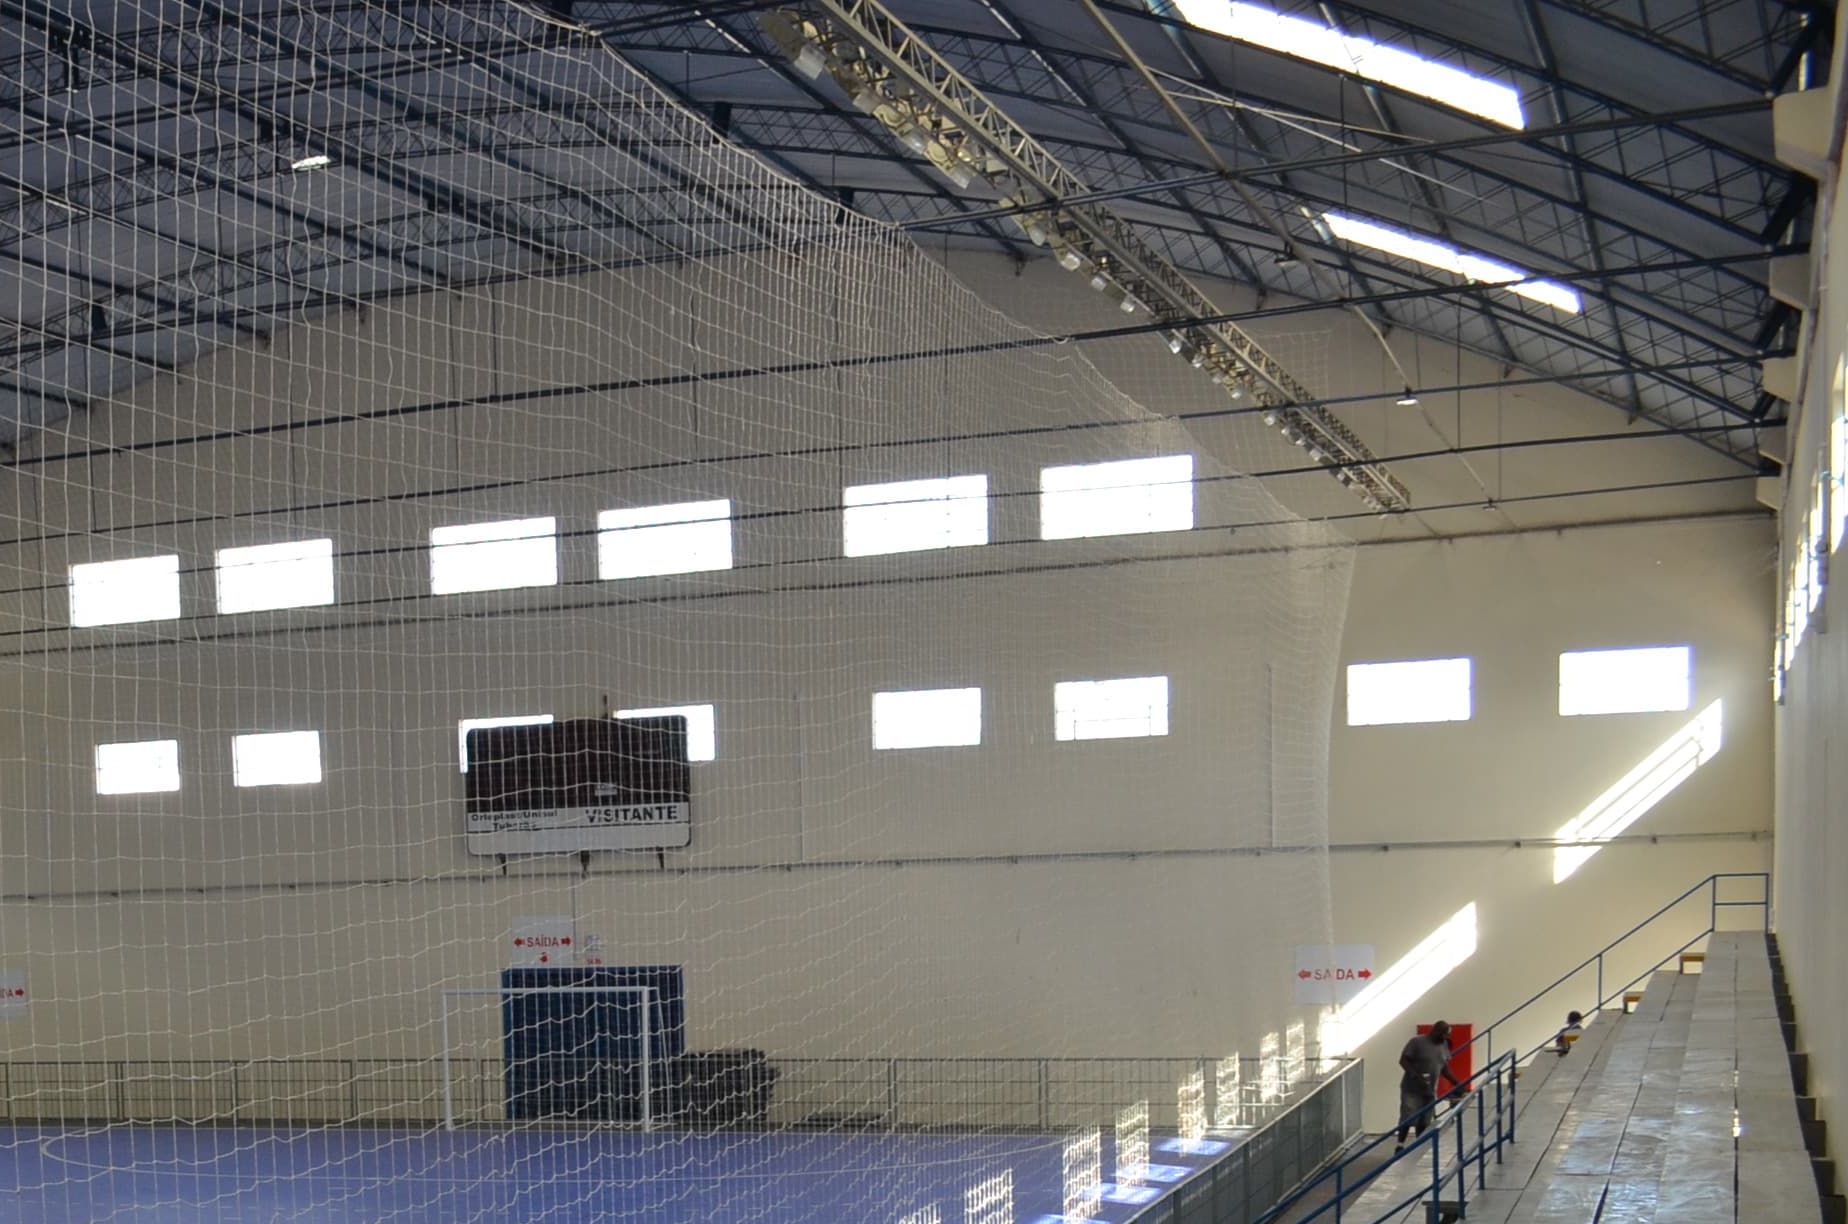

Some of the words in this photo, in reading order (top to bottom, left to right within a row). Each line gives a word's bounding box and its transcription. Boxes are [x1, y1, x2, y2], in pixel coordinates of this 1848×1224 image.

[585, 805, 677, 824] VISITANTE
[526, 934, 560, 948] SAÍDA
[1313, 968, 1355, 981] SADA
